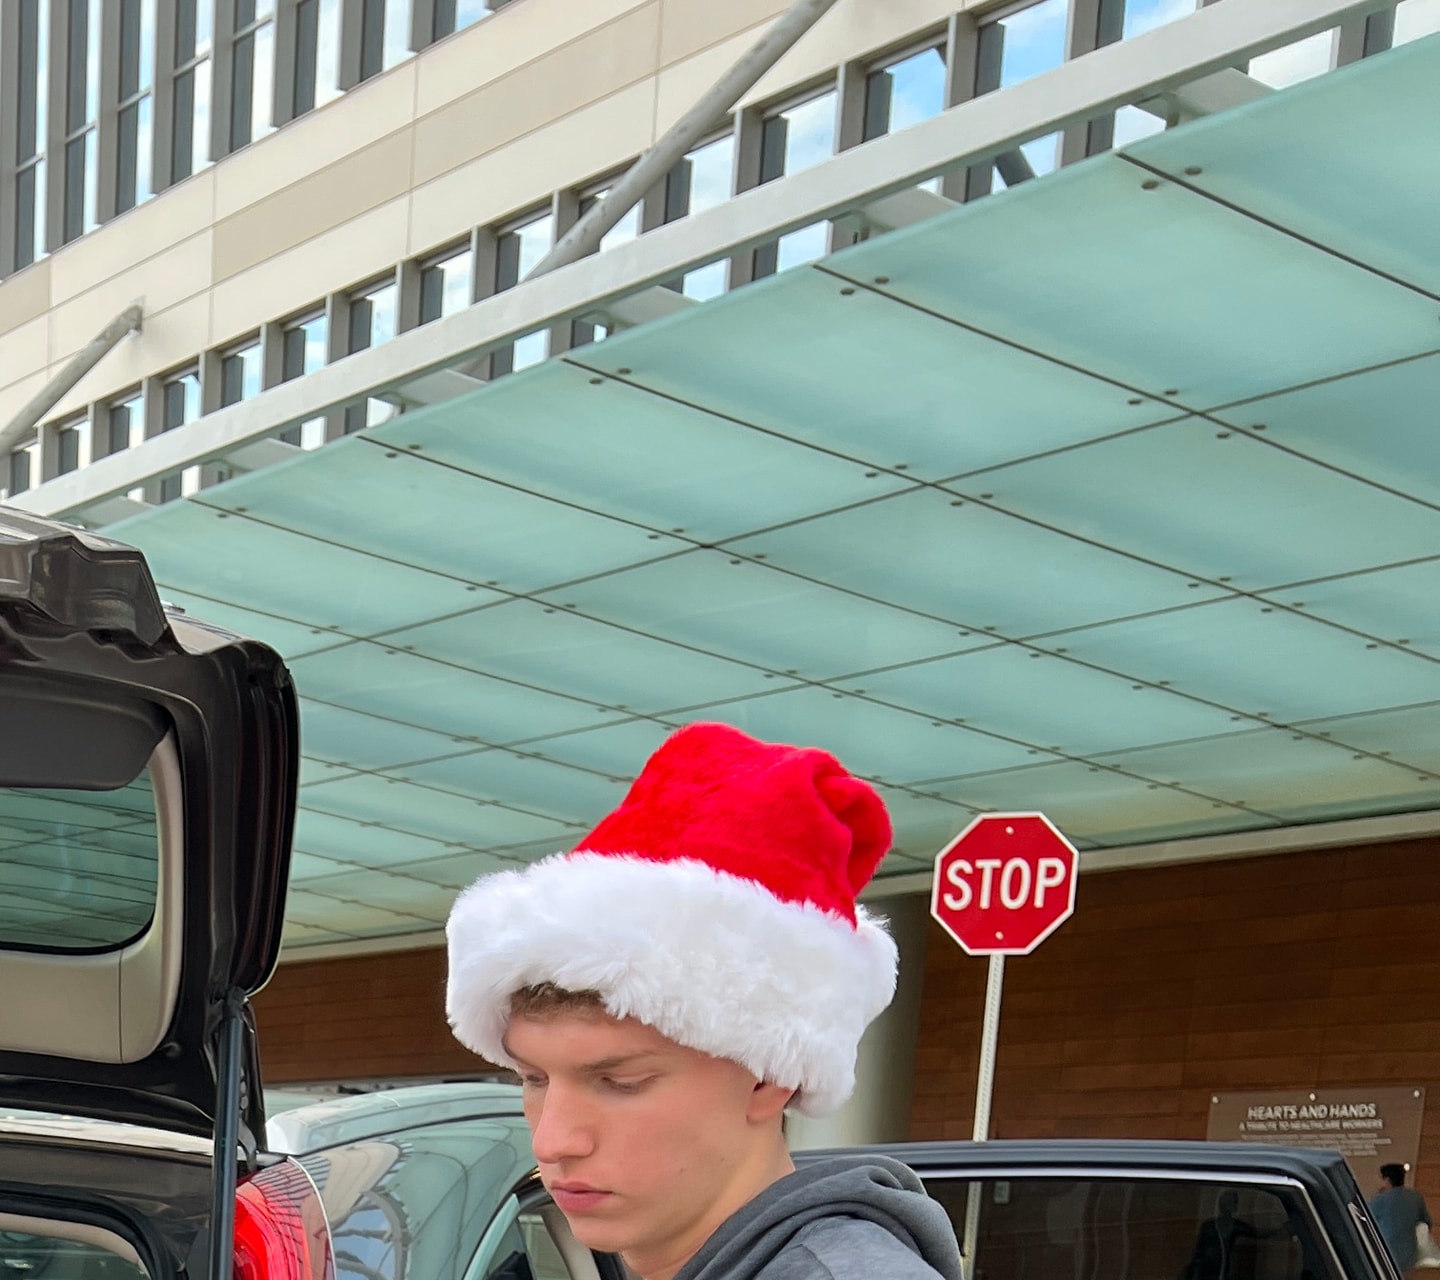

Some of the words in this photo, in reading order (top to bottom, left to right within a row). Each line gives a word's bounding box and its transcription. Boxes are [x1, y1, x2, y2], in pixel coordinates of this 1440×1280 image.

[943, 857, 1066, 911] STOP
[1248, 1105, 1298, 1120] HEARTS
[1299, 1104, 1328, 1119] AND
[1329, 1103, 1377, 1118] HANDS
